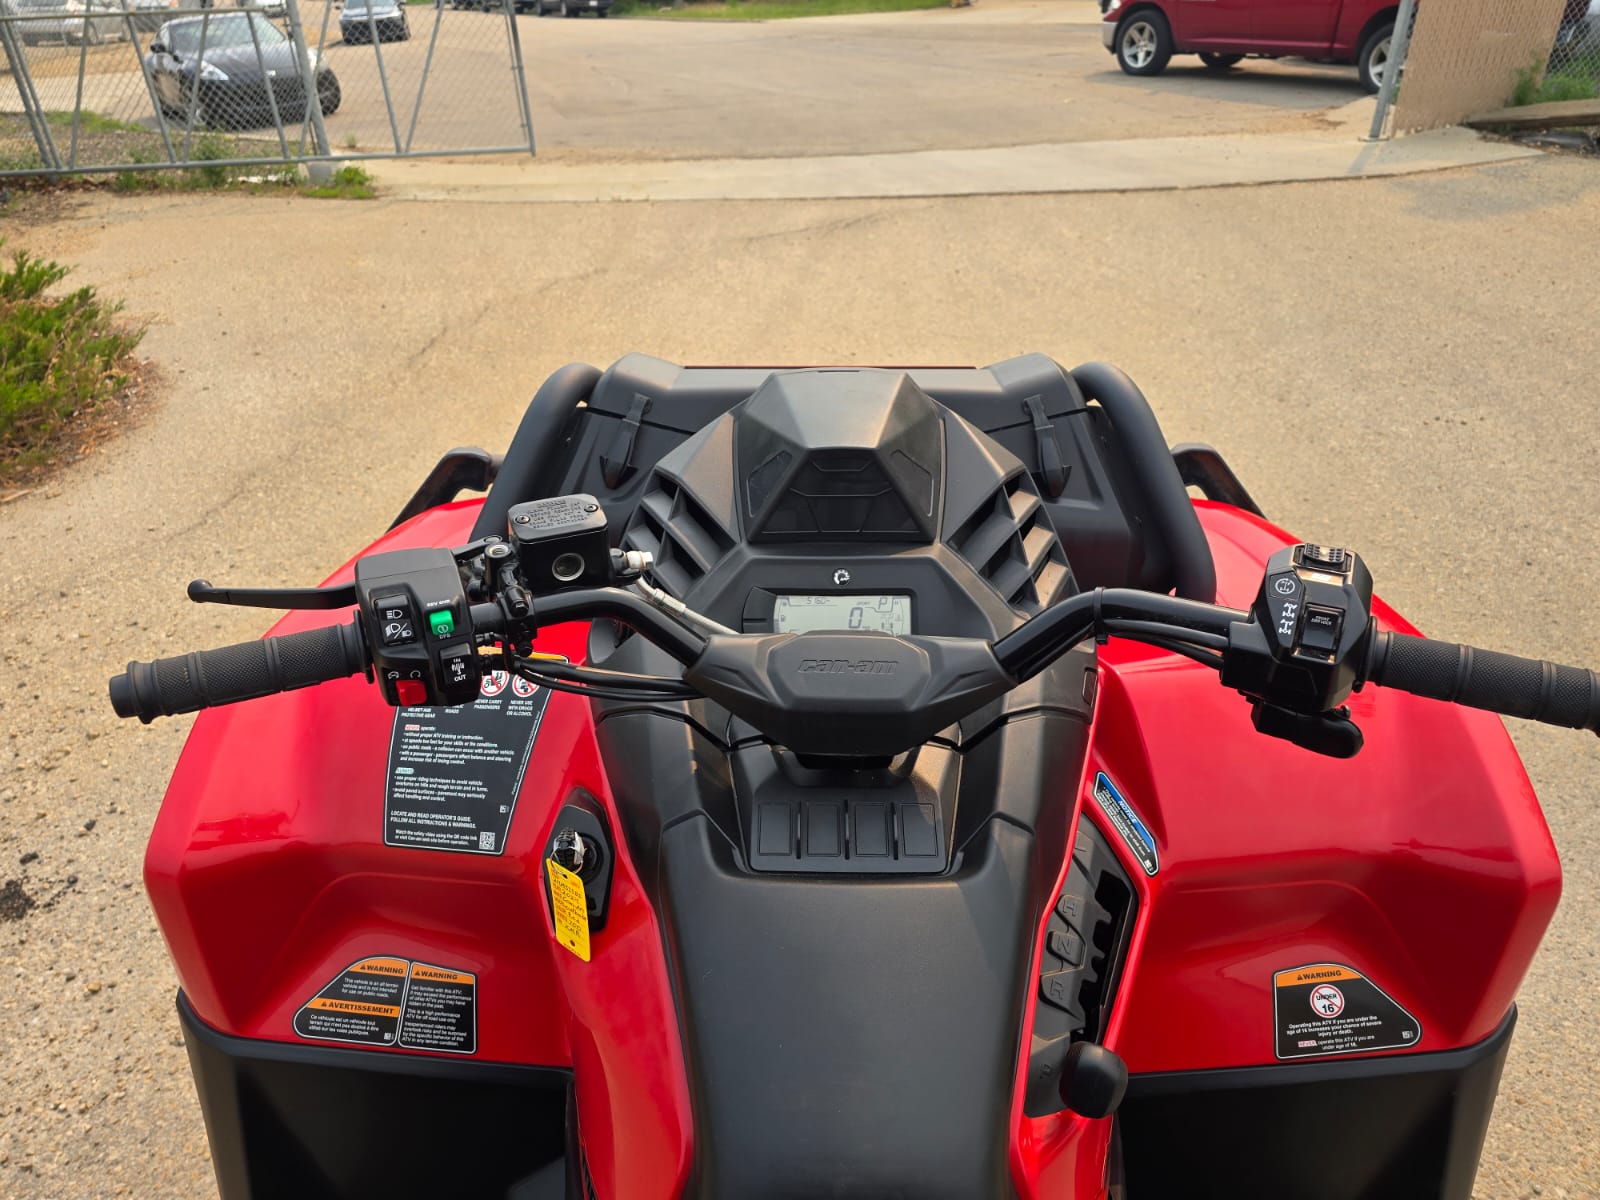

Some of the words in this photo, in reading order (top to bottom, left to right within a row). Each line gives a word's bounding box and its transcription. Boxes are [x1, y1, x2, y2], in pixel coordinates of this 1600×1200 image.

[878, 596, 888, 610] P
[848, 607, 863, 628] 0
[798, 660, 899, 674] can-am
[1118, 800, 1138, 824] NOTICE
[1062, 896, 1077, 918] H
[1057, 935, 1071, 956] N
[366, 965, 404, 974] WARNING
[421, 970, 458, 980] WARNING
[1303, 970, 1342, 980] WARNING
[1316, 993, 1337, 1002] UNDER
[328, 1001, 394, 1014] AVERTISSEMENT
[1322, 1004, 1335, 1014] 16
